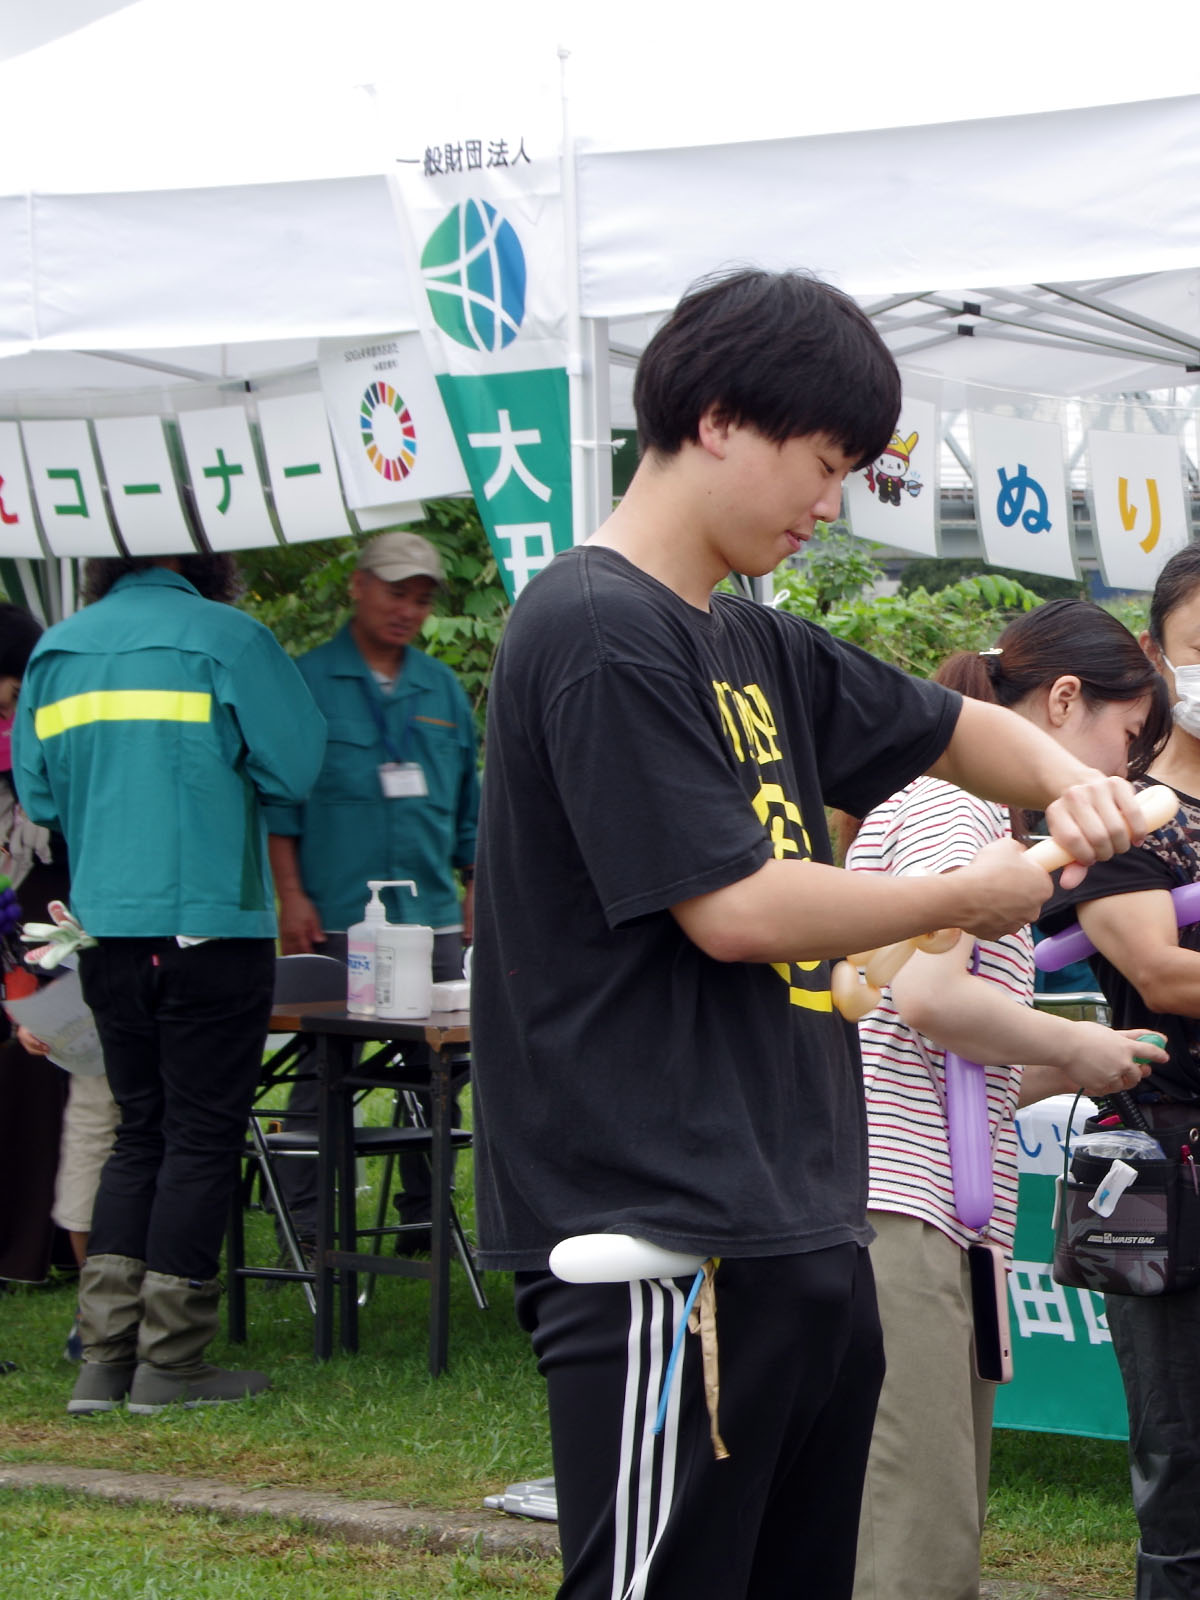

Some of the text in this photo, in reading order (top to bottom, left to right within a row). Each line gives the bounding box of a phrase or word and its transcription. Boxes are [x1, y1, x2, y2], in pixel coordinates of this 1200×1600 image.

[396, 135, 532, 177] 一般財団法人
[1112, 1236, 1137, 1244] WAIST
[1137, 1236, 1155, 1244] BAG
